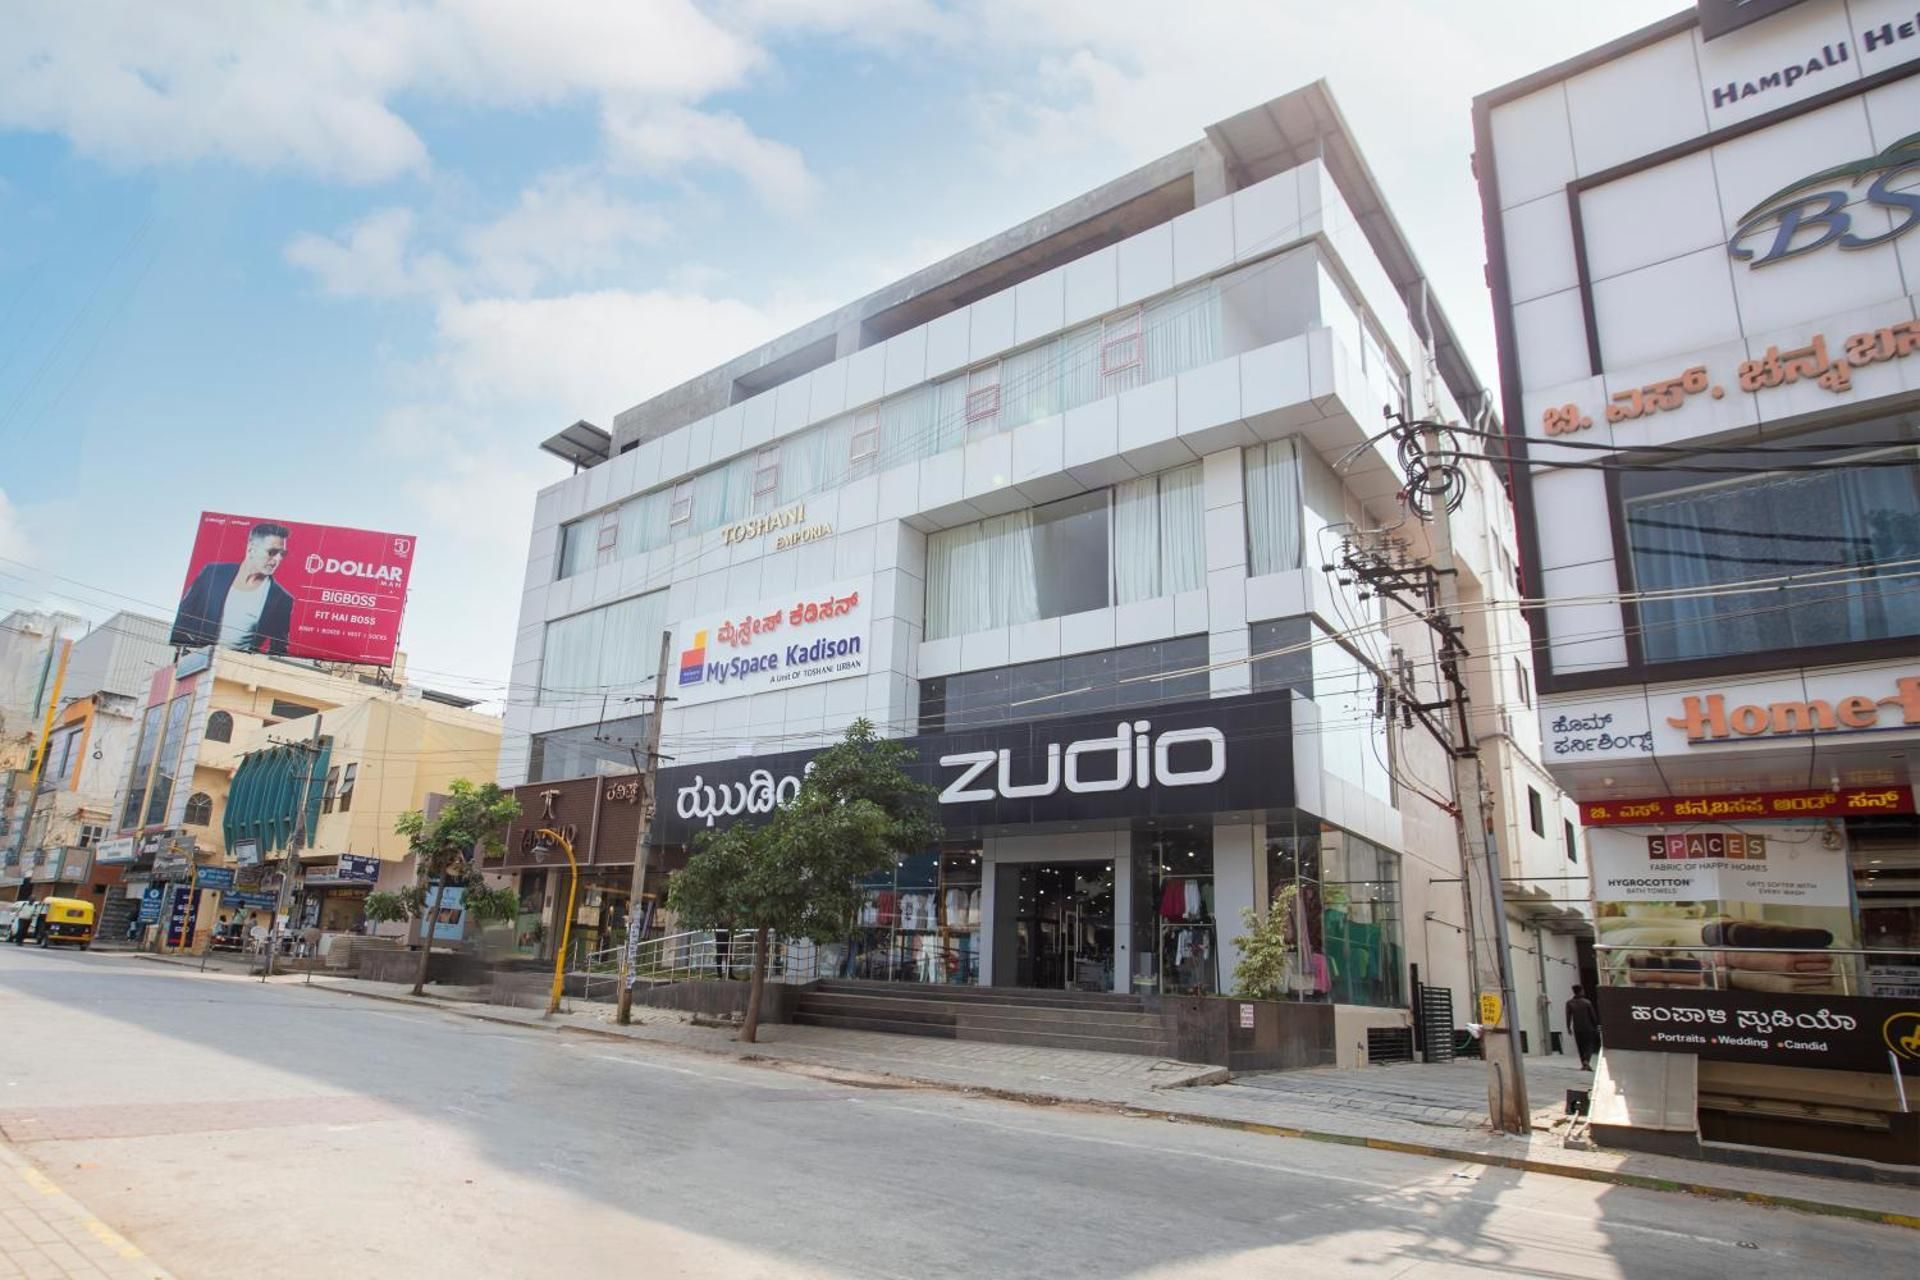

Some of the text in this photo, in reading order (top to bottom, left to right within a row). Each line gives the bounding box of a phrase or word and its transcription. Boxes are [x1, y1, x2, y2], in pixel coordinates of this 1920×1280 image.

[1863, 12, 1920, 52] HE
[721, 503, 805, 546] TOSHANI
[776, 522, 832, 550] EMPORIA
[325, 558, 403, 582] DOLLAR
[321, 590, 377, 607] BIGBOSS
[315, 611, 376, 625] FIT HAI BOSS
[706, 635, 861, 684] MySpace Kadison
[837, 660, 862, 672] URBAN
[1667, 693, 1879, 740] Home
[1651, 837, 1763, 854] SPACES
[1650, 861, 1768, 872] FABRIC OF HAPPY HOMES
[1657, 1032, 1828, 1051] Portraits Wedding Candid
